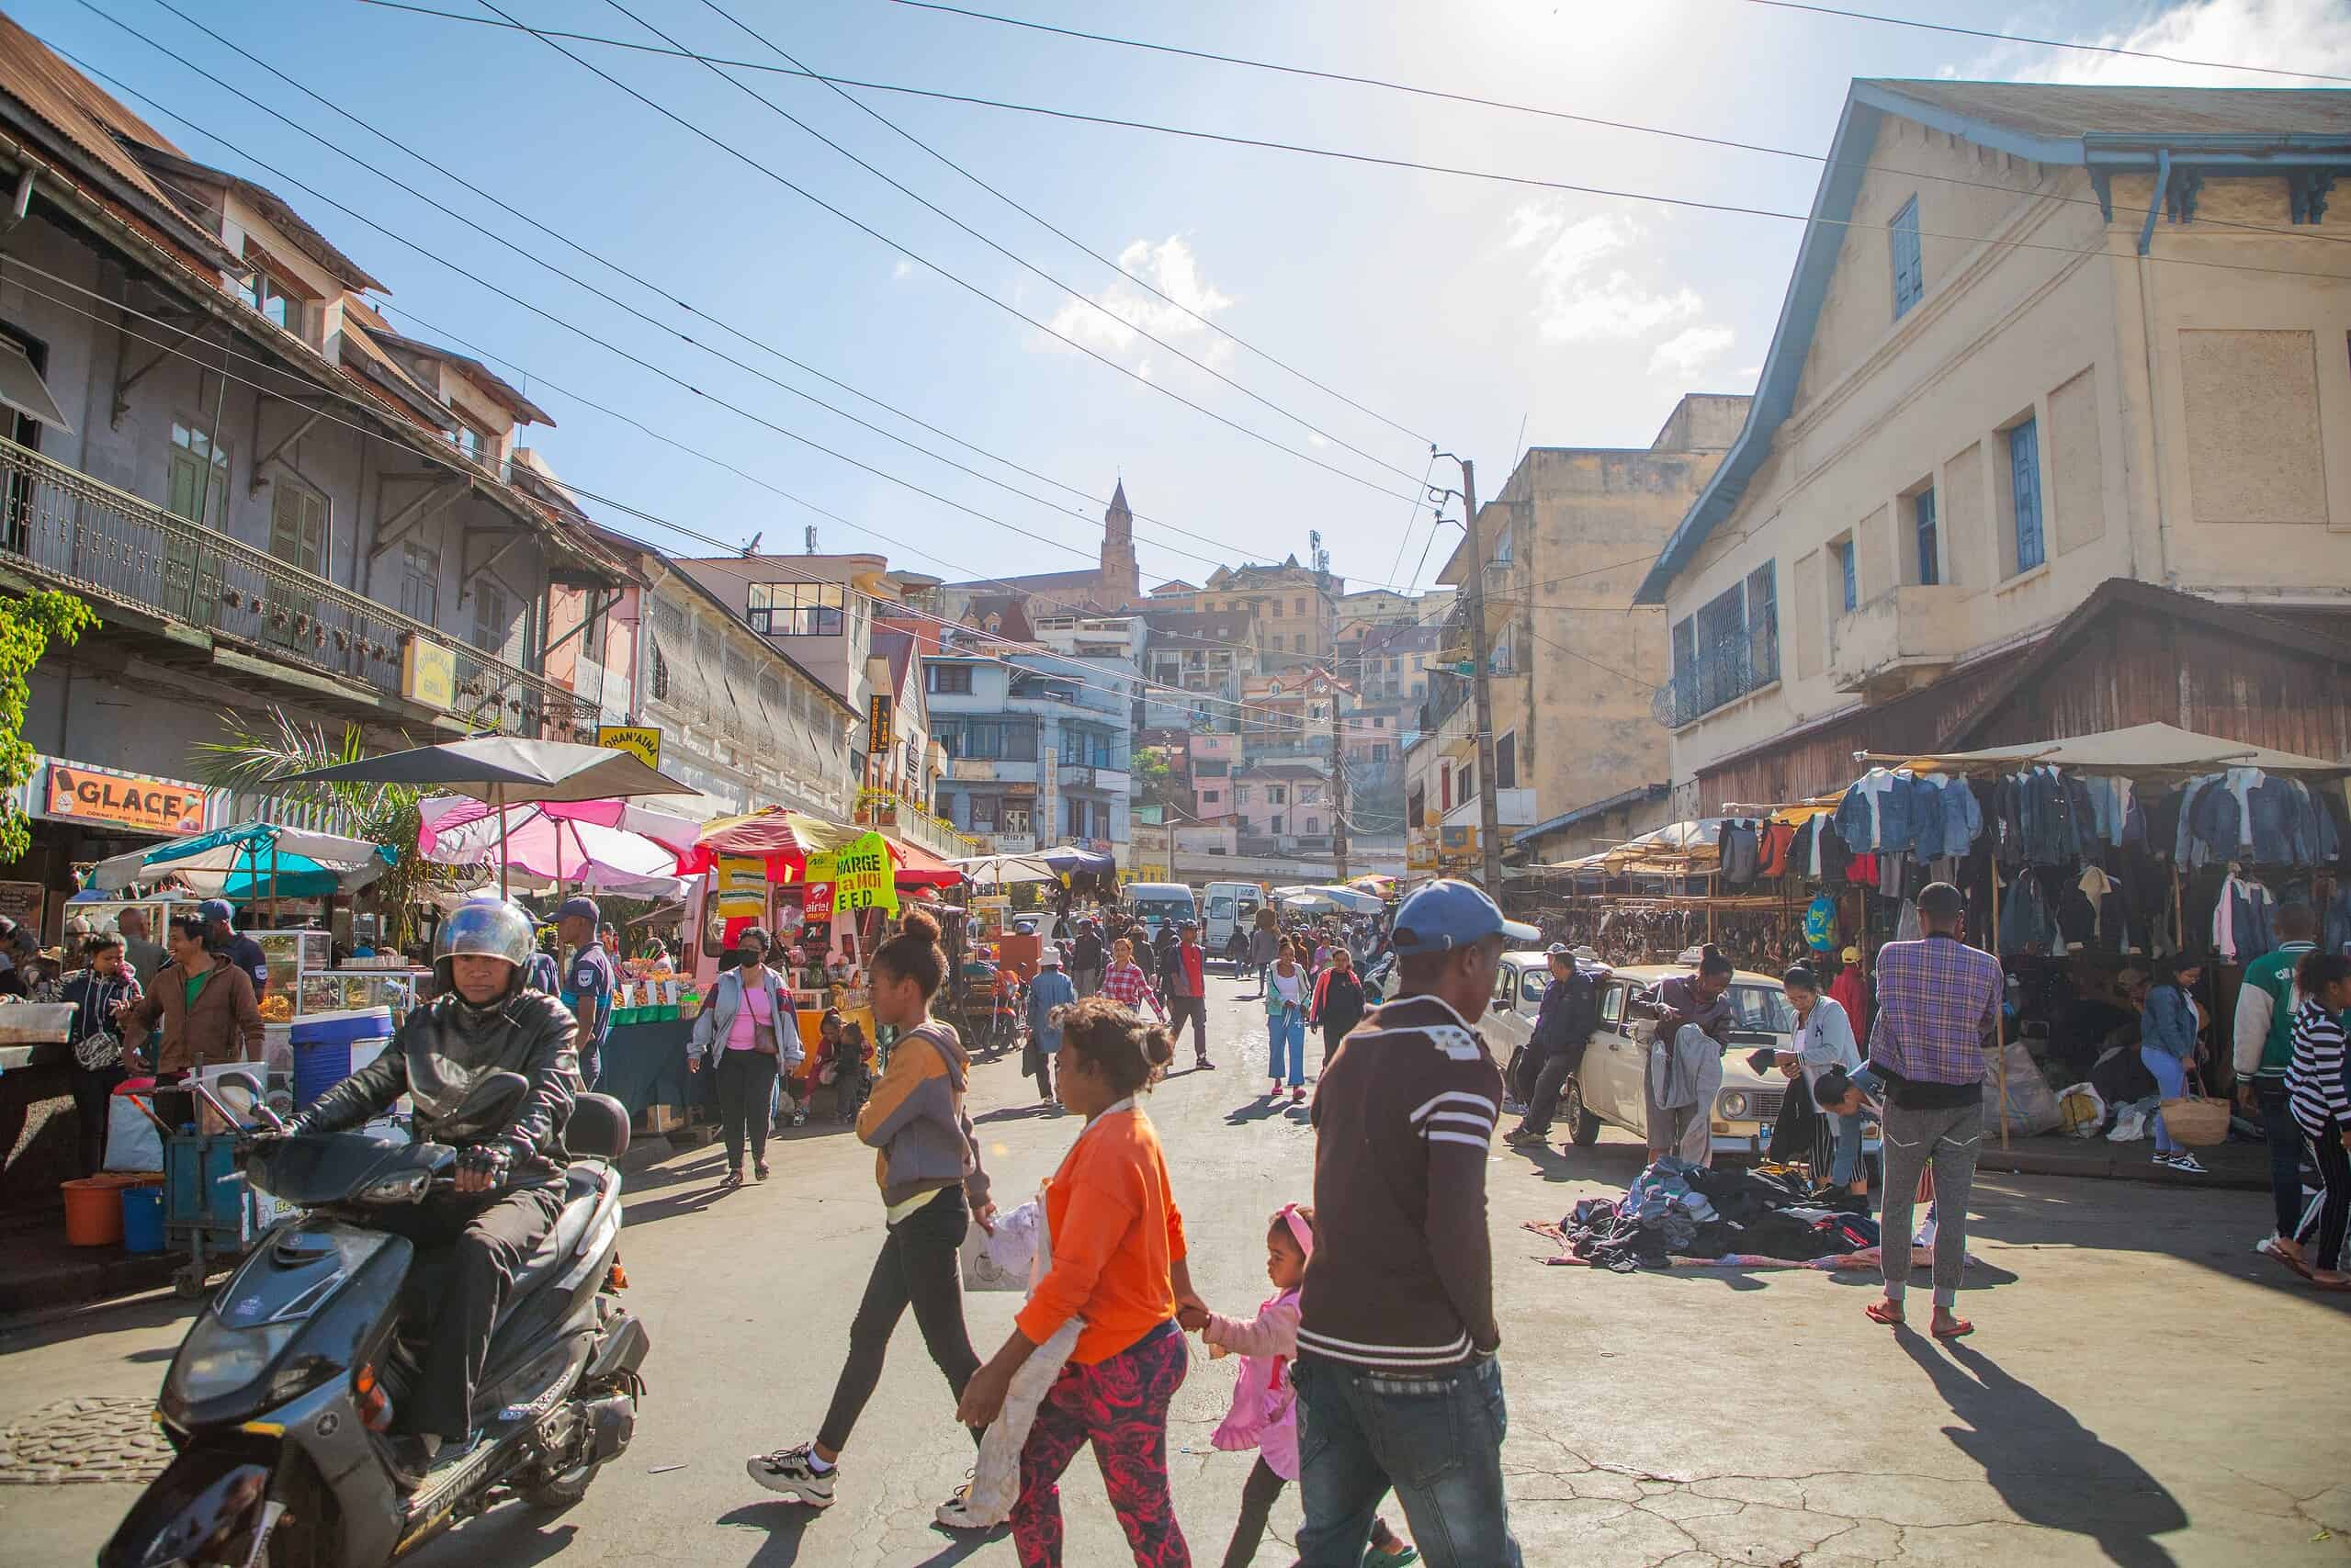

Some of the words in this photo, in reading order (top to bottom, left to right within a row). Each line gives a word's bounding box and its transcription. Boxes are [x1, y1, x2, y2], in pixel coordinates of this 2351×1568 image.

[605, 732, 657, 756] OHAN'AINA
[77, 781, 181, 821] GLACE
[836, 854, 880, 876] HARGE
[806, 901, 829, 912] airtel
[839, 890, 873, 910] EED
[439, 1461, 487, 1509] YAMAHA
